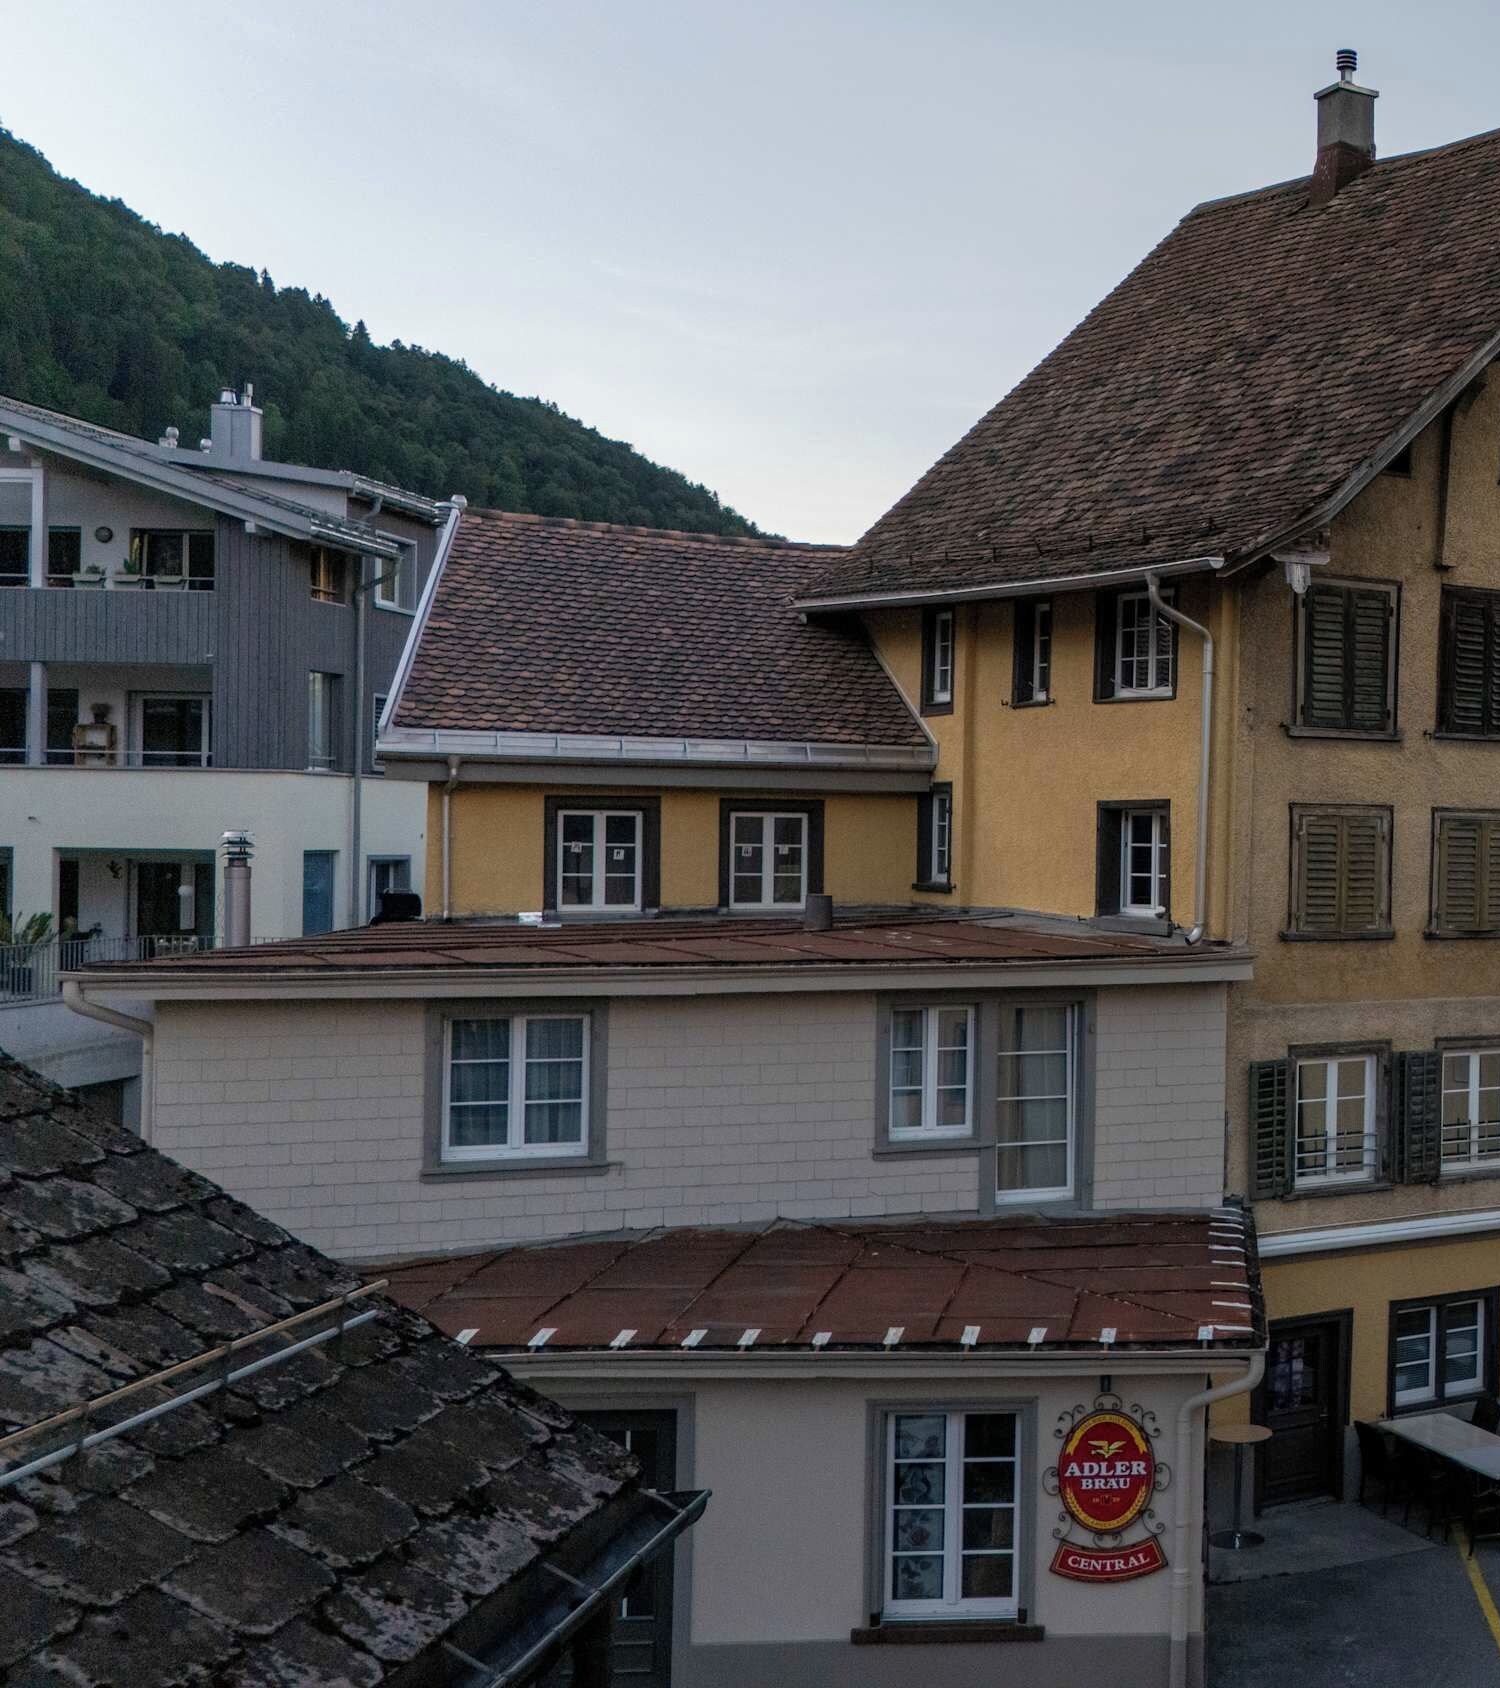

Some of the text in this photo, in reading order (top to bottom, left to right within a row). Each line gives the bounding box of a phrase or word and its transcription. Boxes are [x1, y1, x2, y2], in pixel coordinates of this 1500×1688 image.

[1064, 1460, 1147, 1477] ADLER
[1080, 1477, 1131, 1490] BRÄU
[1067, 1553, 1150, 1571] CENTRAL
